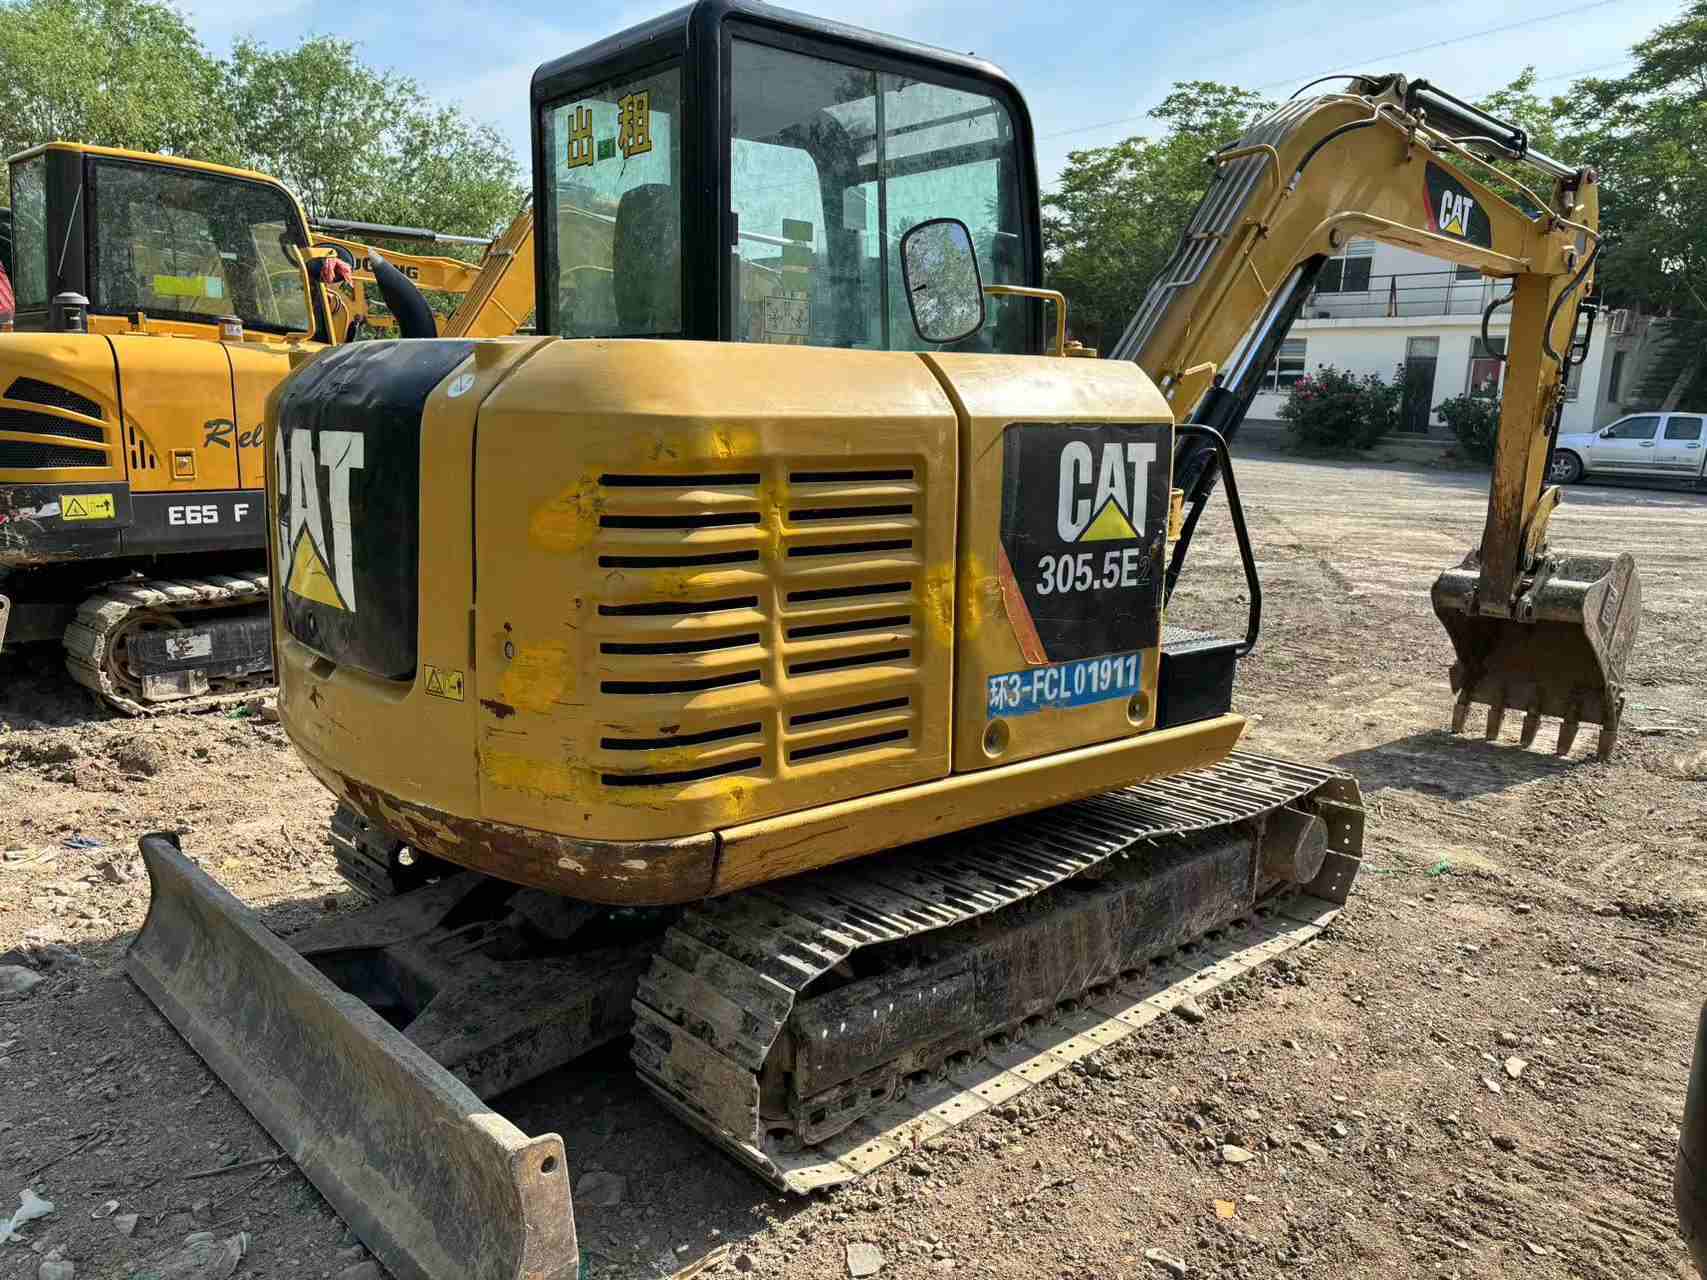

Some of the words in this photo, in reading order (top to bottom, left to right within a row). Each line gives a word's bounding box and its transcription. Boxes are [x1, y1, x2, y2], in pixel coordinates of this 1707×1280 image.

[567, 89, 652, 169] 出租
[1439, 190, 1473, 237] CAT
[168, 505, 219, 525] E65
[234, 503, 249, 522] F
[1057, 441, 1157, 543] CAT
